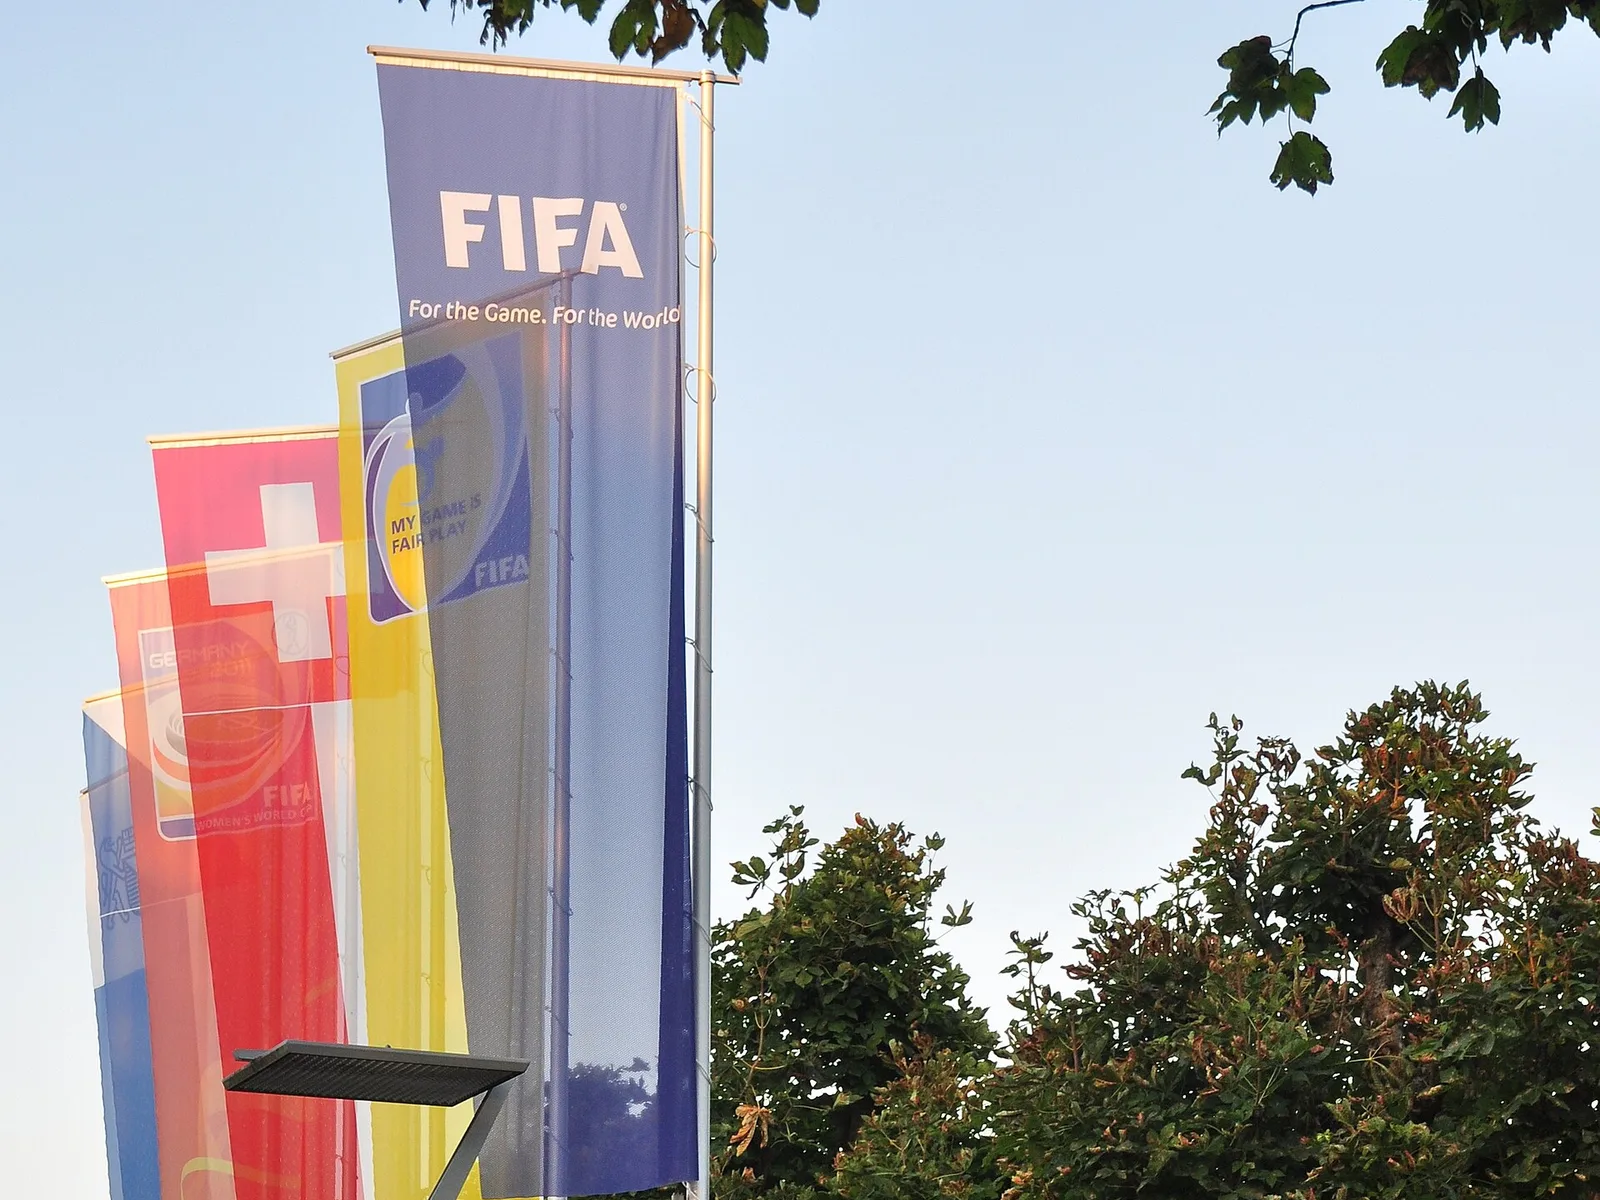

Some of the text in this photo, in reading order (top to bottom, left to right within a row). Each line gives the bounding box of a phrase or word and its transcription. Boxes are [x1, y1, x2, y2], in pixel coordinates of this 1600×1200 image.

[440, 190, 644, 279] FIFA
[408, 299, 681, 330] For the Game. For the World
[391, 493, 482, 535] MY GAME IS
[391, 520, 466, 554] FAIR PLAY
[474, 554, 529, 587] FIFA
[149, 641, 250, 669] GERMANY
[253, 807, 297, 822] WORLD
